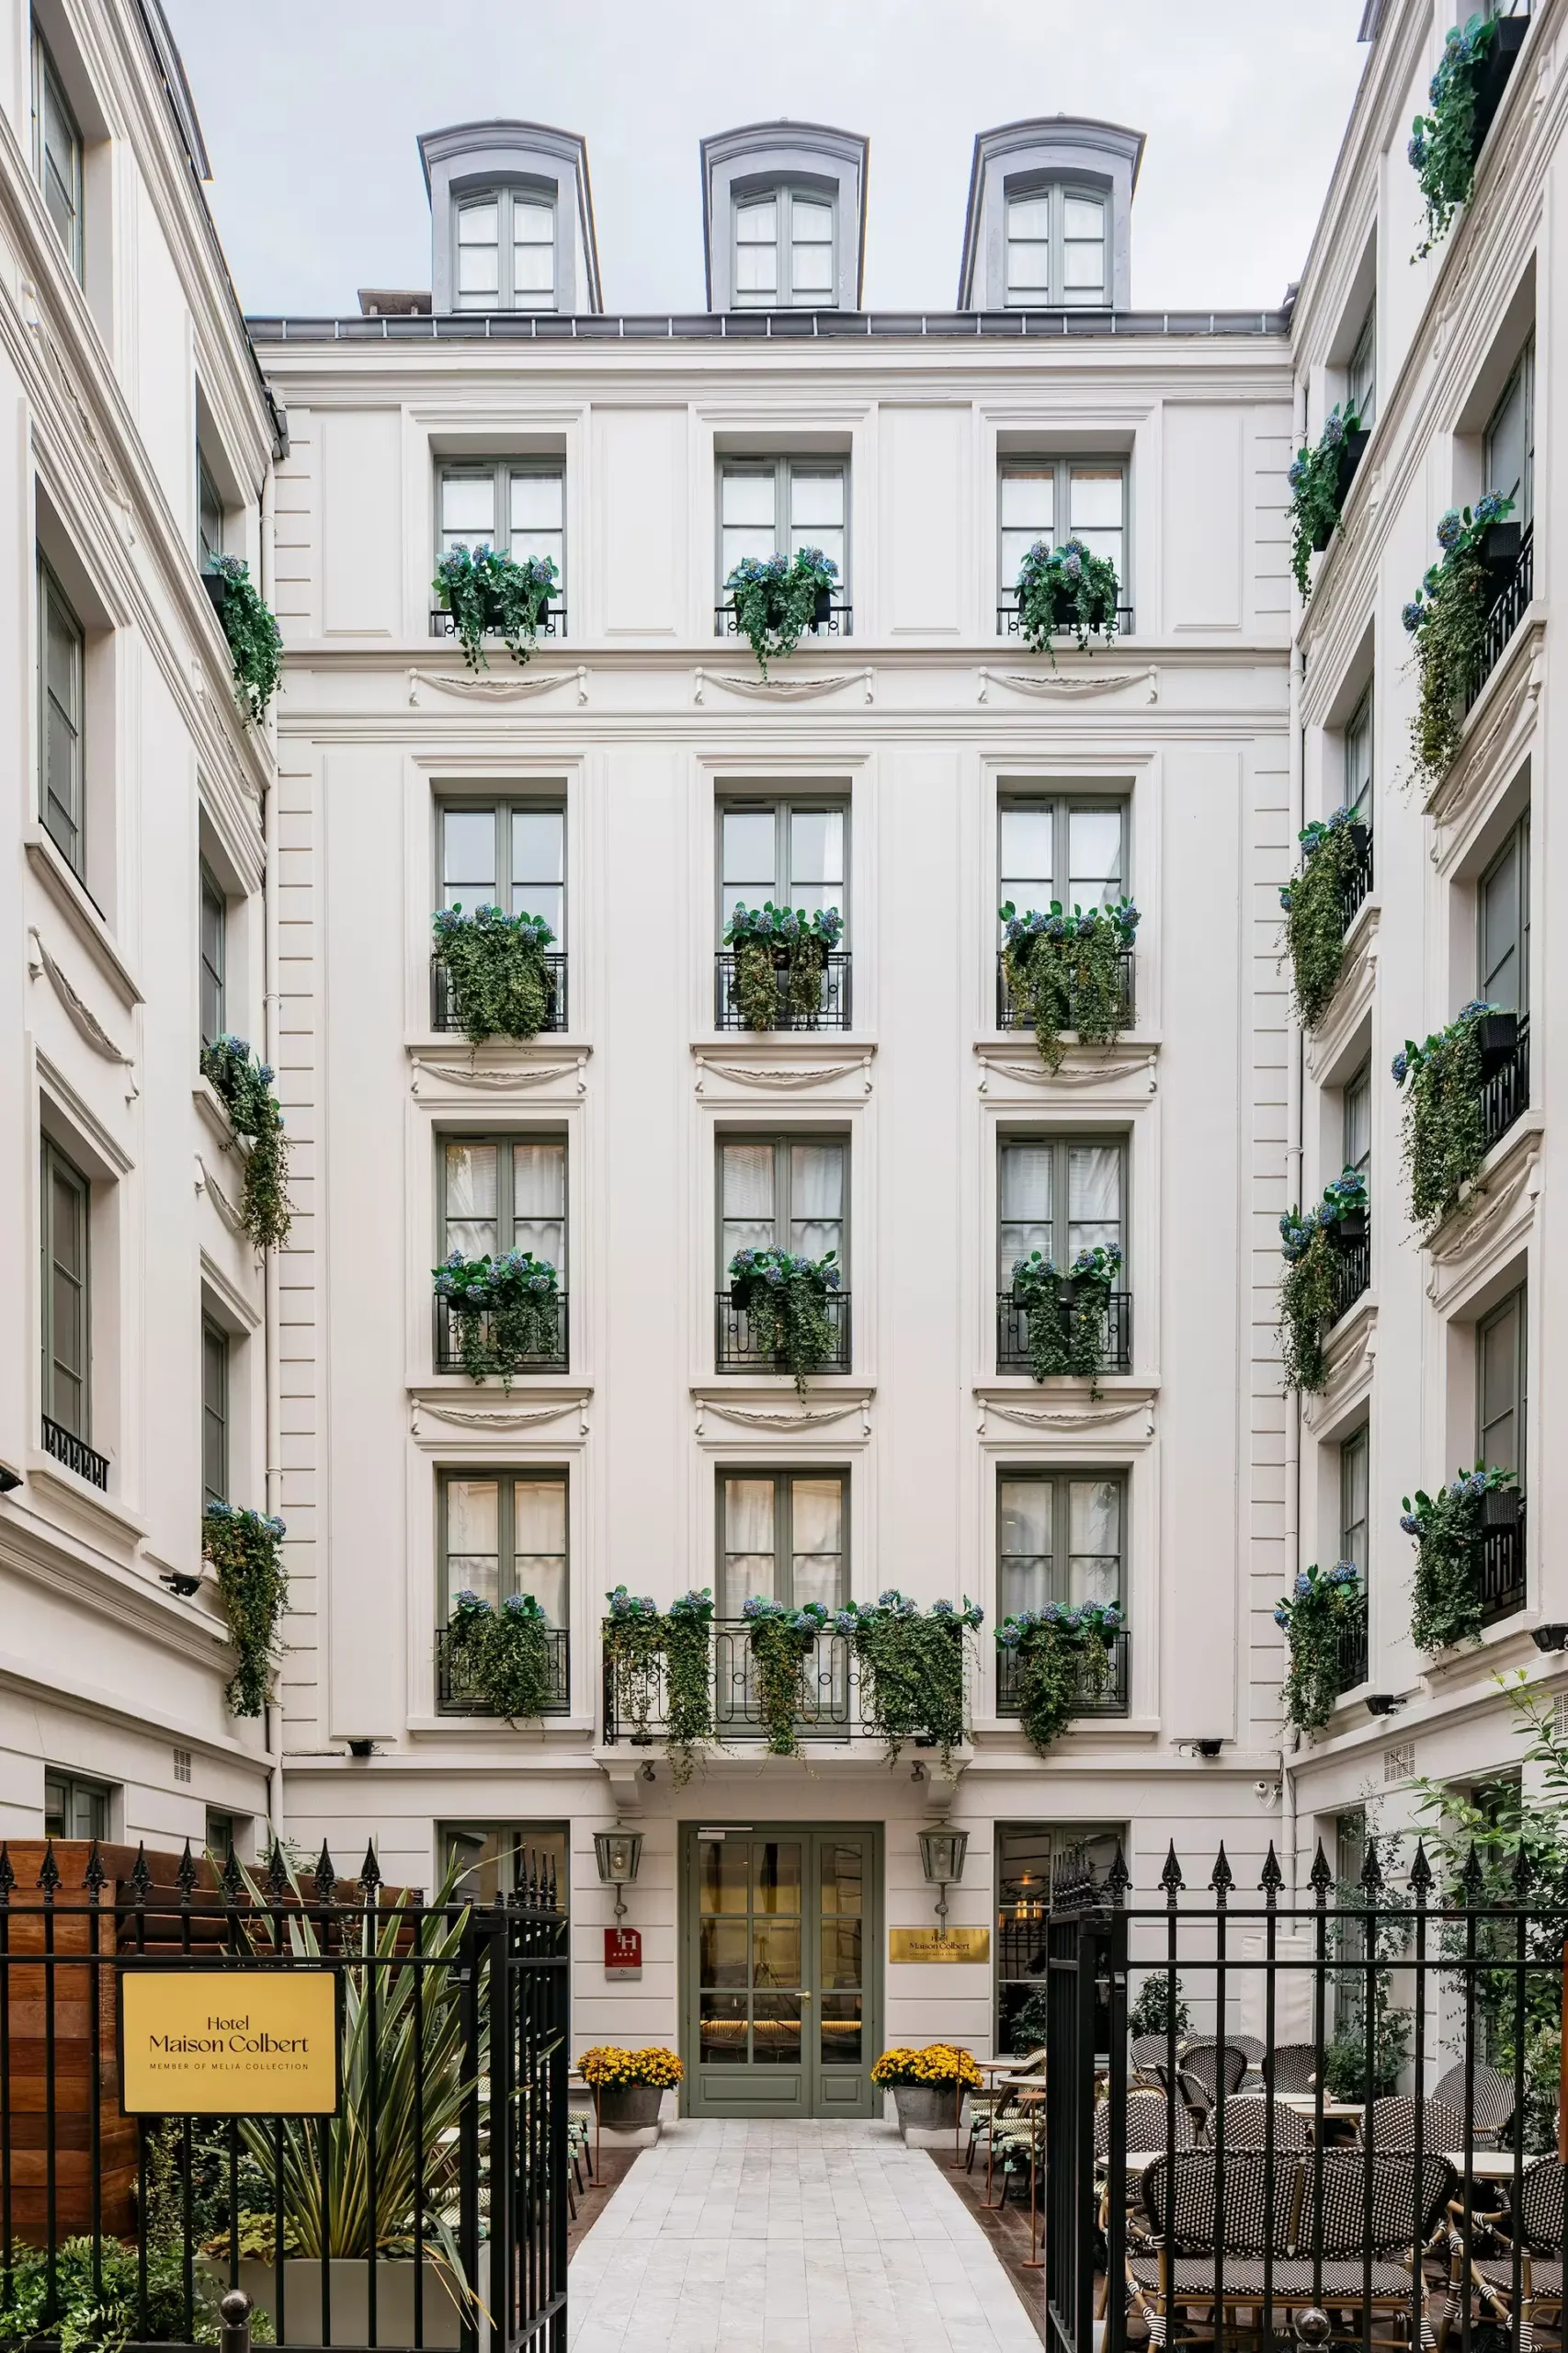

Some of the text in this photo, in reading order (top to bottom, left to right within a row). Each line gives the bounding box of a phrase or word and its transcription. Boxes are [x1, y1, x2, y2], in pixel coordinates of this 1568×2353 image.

[620, 1935, 638, 1949] H
[939, 1941, 970, 1949] Colbert
[208, 2015, 249, 2029] Hotel
[150, 2033, 309, 2052] Maison Colbert
